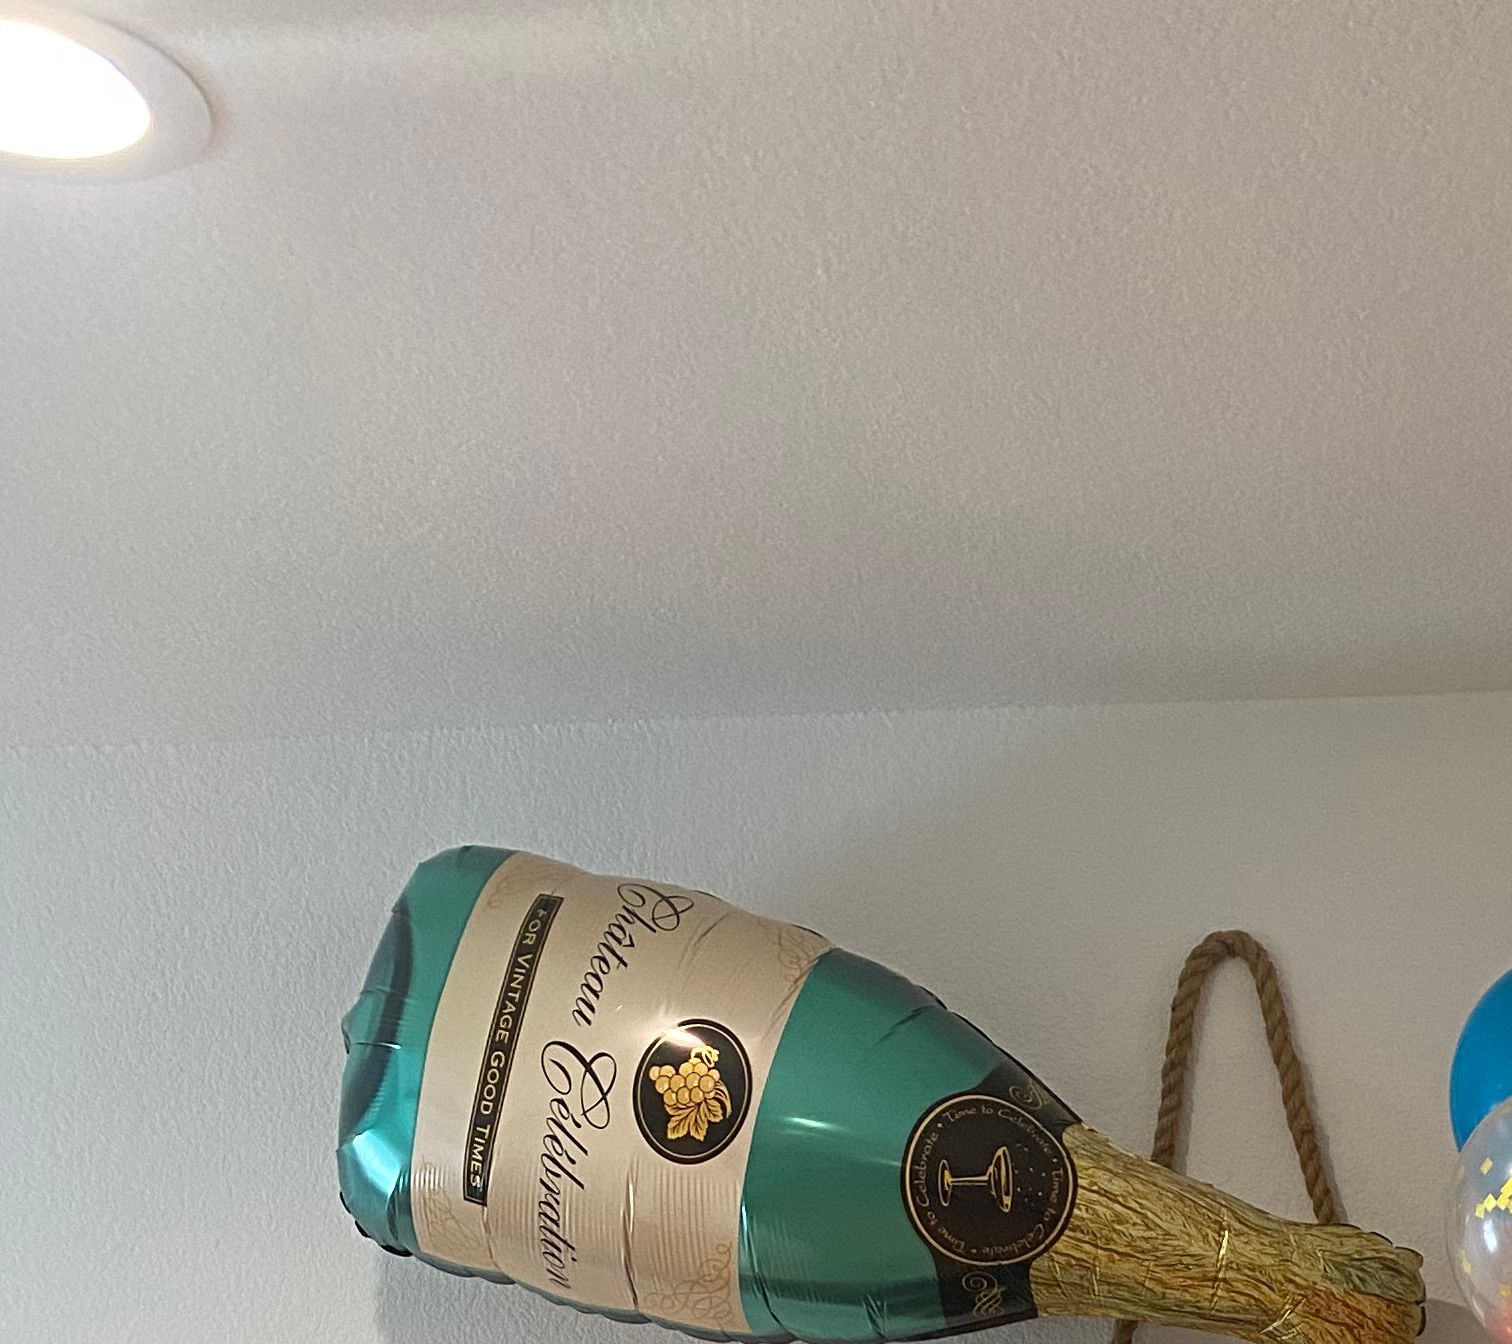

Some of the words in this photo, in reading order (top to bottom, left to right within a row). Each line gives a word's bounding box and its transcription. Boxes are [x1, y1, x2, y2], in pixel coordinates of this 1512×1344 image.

[522, 907, 548, 945] FOR
[572, 883, 694, 1028] Château
[495, 954, 533, 1043] VINTAGE
[479, 1050, 506, 1115] GOOD
[943, 1106, 977, 1122] Time
[982, 1105, 993, 1114] to
[469, 1123, 491, 1188] TIMES
[538, 1040, 617, 1290] Célébration
[913, 1131, 939, 1207] Celebrate
[1051, 1167, 1064, 1203] Time
[927, 1211, 938, 1225] to
[937, 1227, 965, 1251] Time
[1043, 1208, 1056, 1222] to
